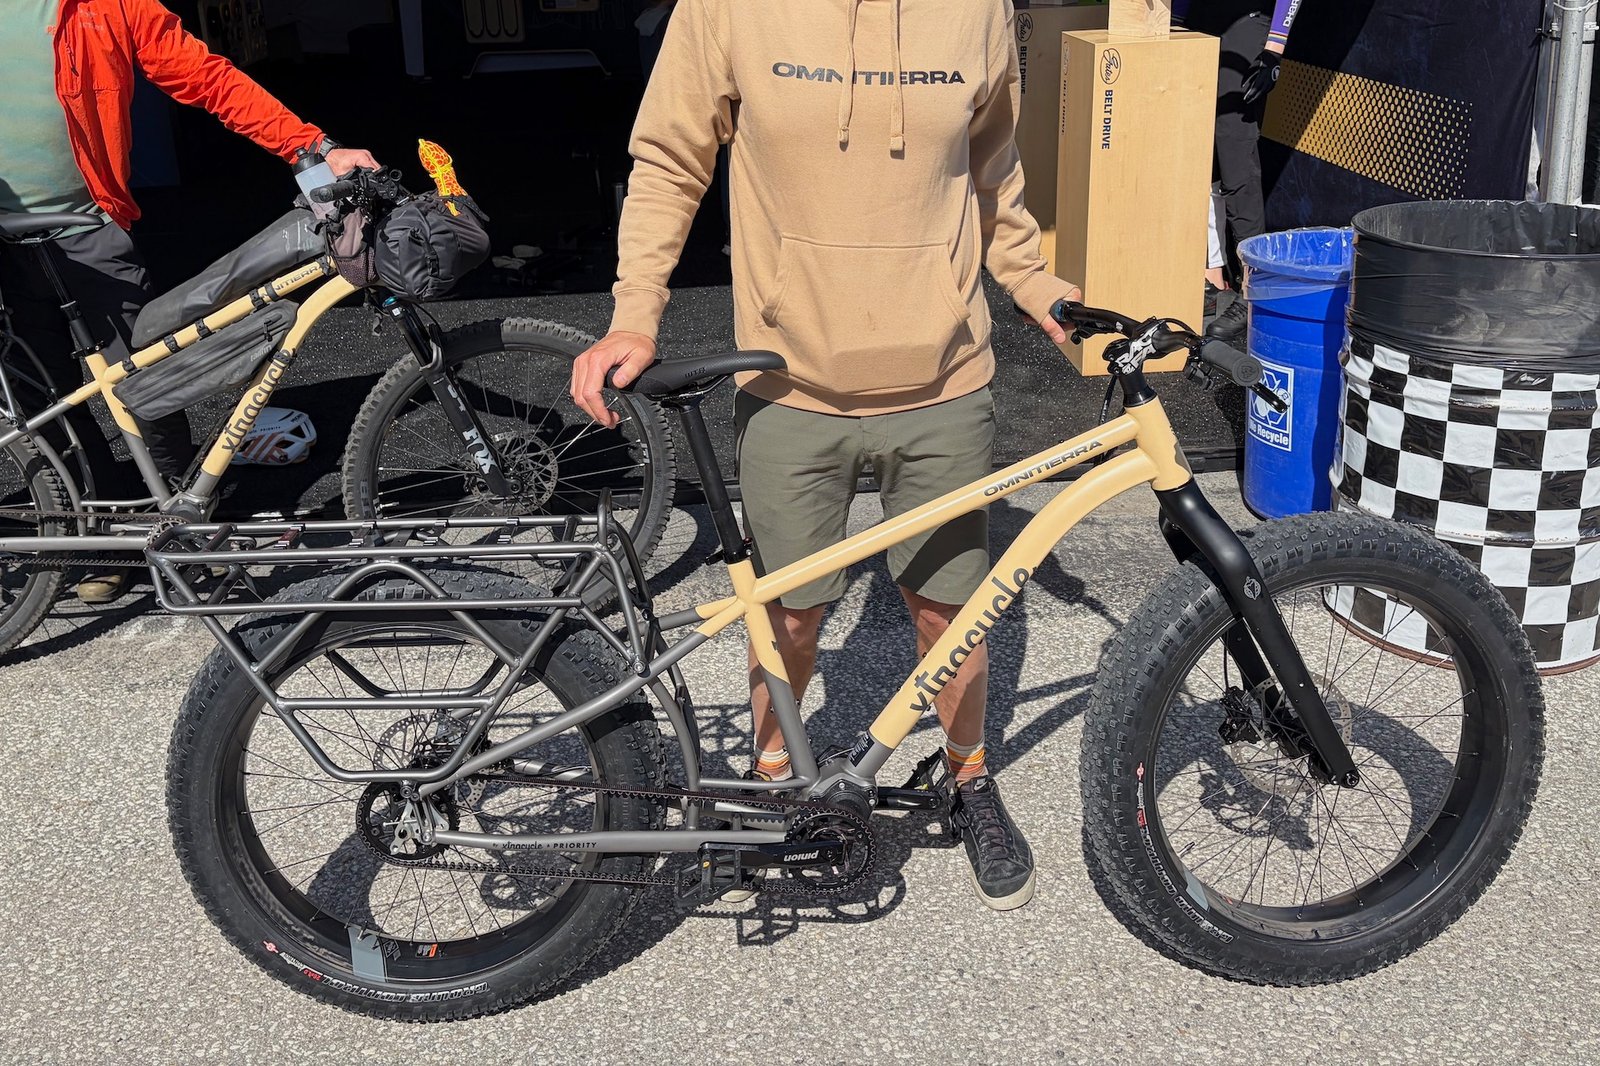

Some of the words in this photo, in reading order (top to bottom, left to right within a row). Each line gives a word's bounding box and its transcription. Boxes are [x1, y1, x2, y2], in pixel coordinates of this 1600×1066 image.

[1019, 68, 1027, 94] DRIVE
[1103, 89, 1113, 115] BELT
[1101, 117, 1112, 150] DRIVE
[1257, 424, 1289, 446] Recycle
[462, 426, 498, 474] FOX
[983, 439, 1103, 497] OMNITIERRA
[783, 849, 820, 862] pinion
